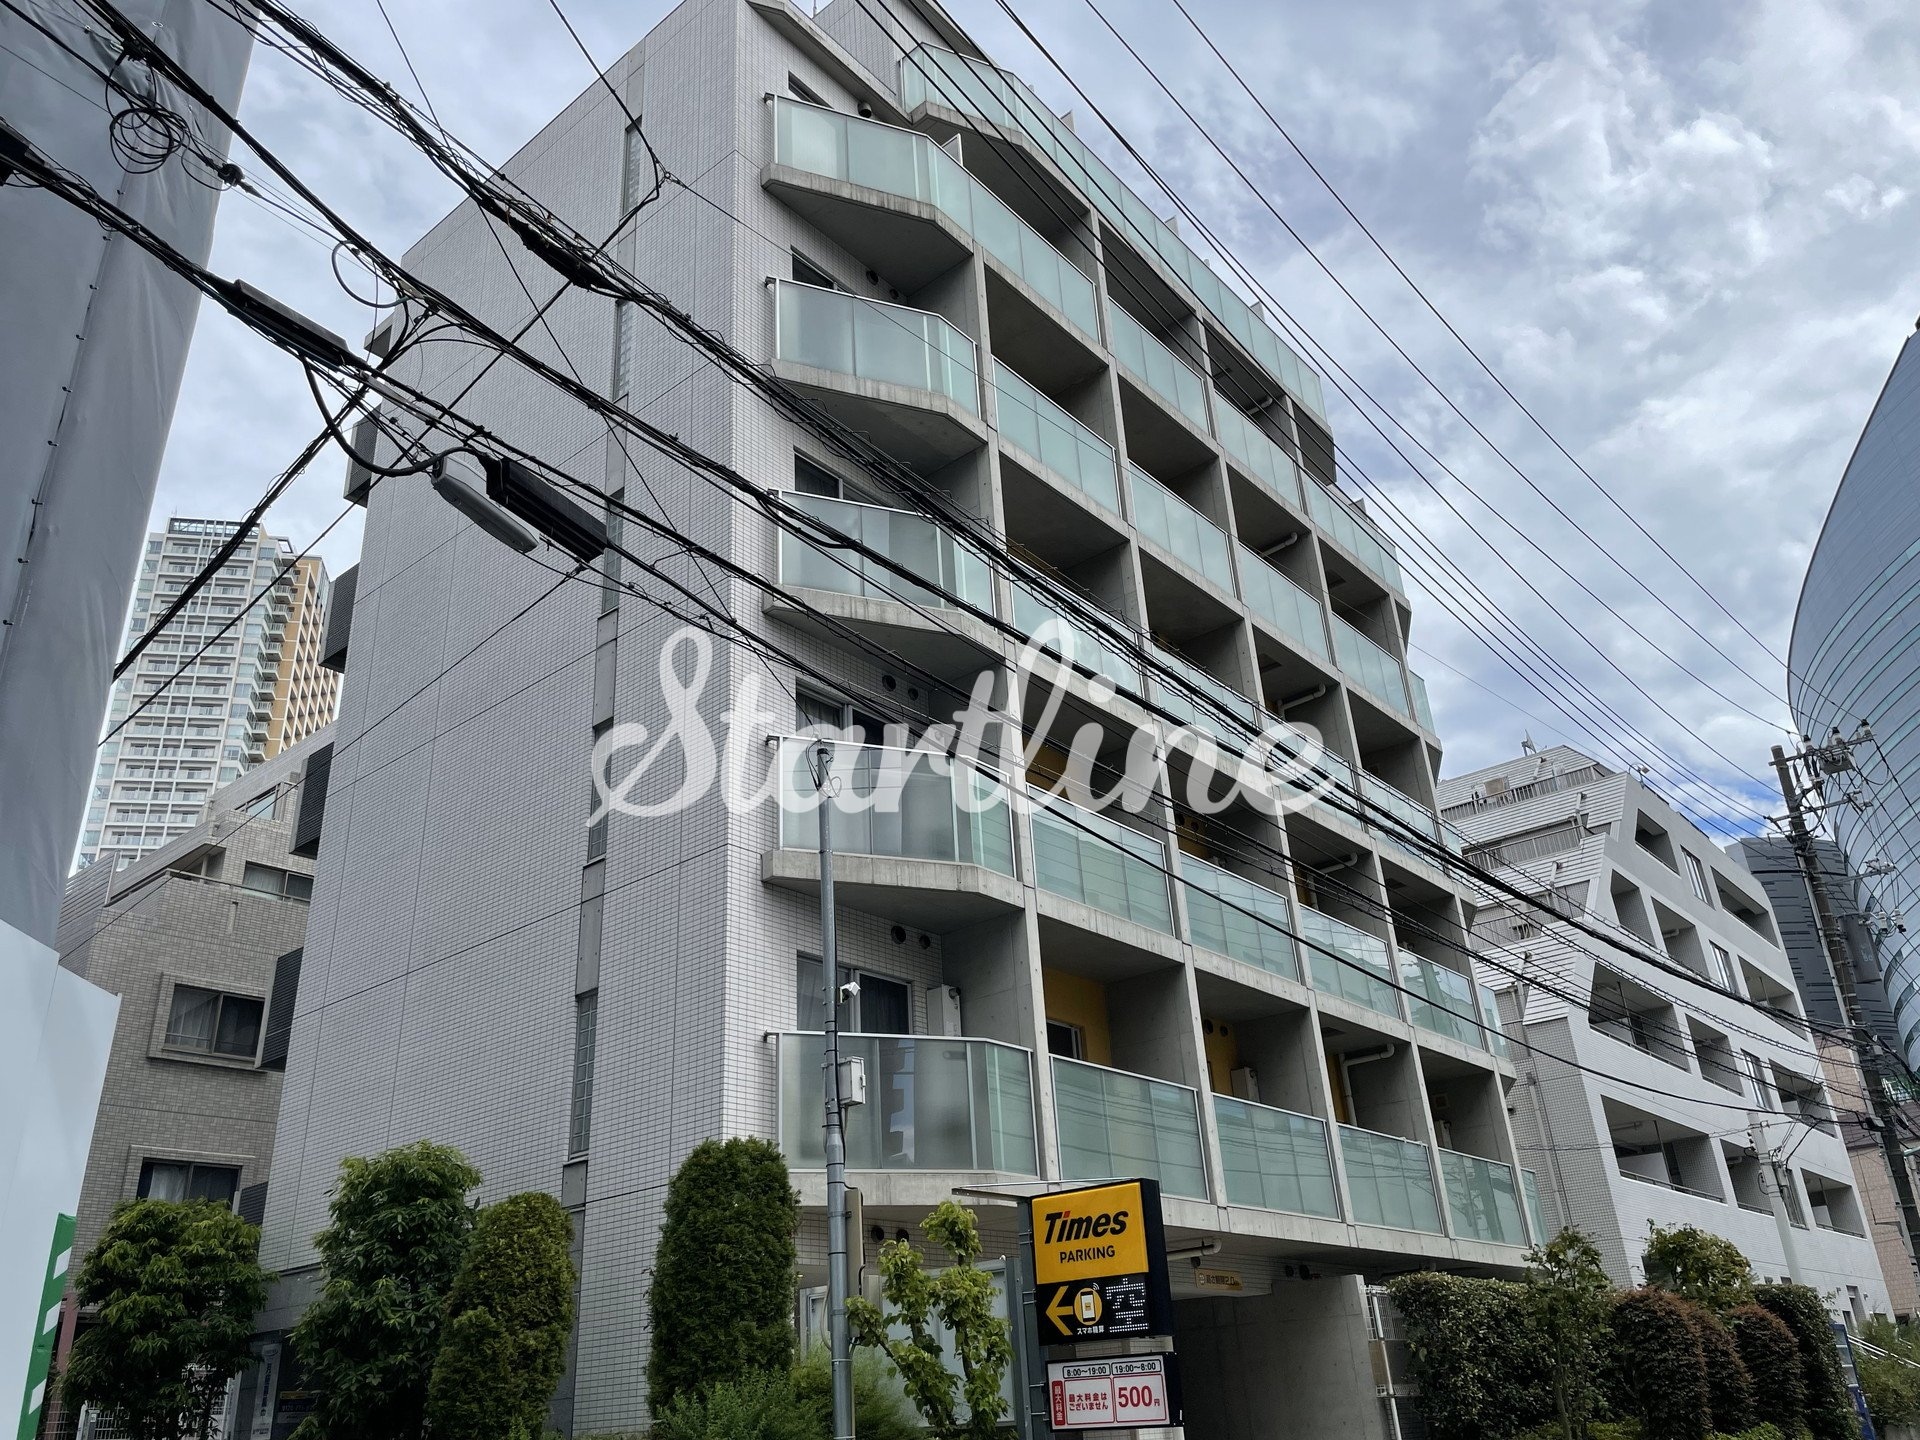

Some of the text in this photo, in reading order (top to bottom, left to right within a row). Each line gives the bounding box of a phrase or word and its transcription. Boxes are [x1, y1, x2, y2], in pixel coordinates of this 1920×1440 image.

[1044, 1210, 1129, 1244] Times
[1060, 1245, 1115, 1263] PARKING
[1106, 1278, 1149, 1332] 空
[1068, 1393, 1107, 1402] 最大料金は
[1069, 1402, 1109, 1411] ございません
